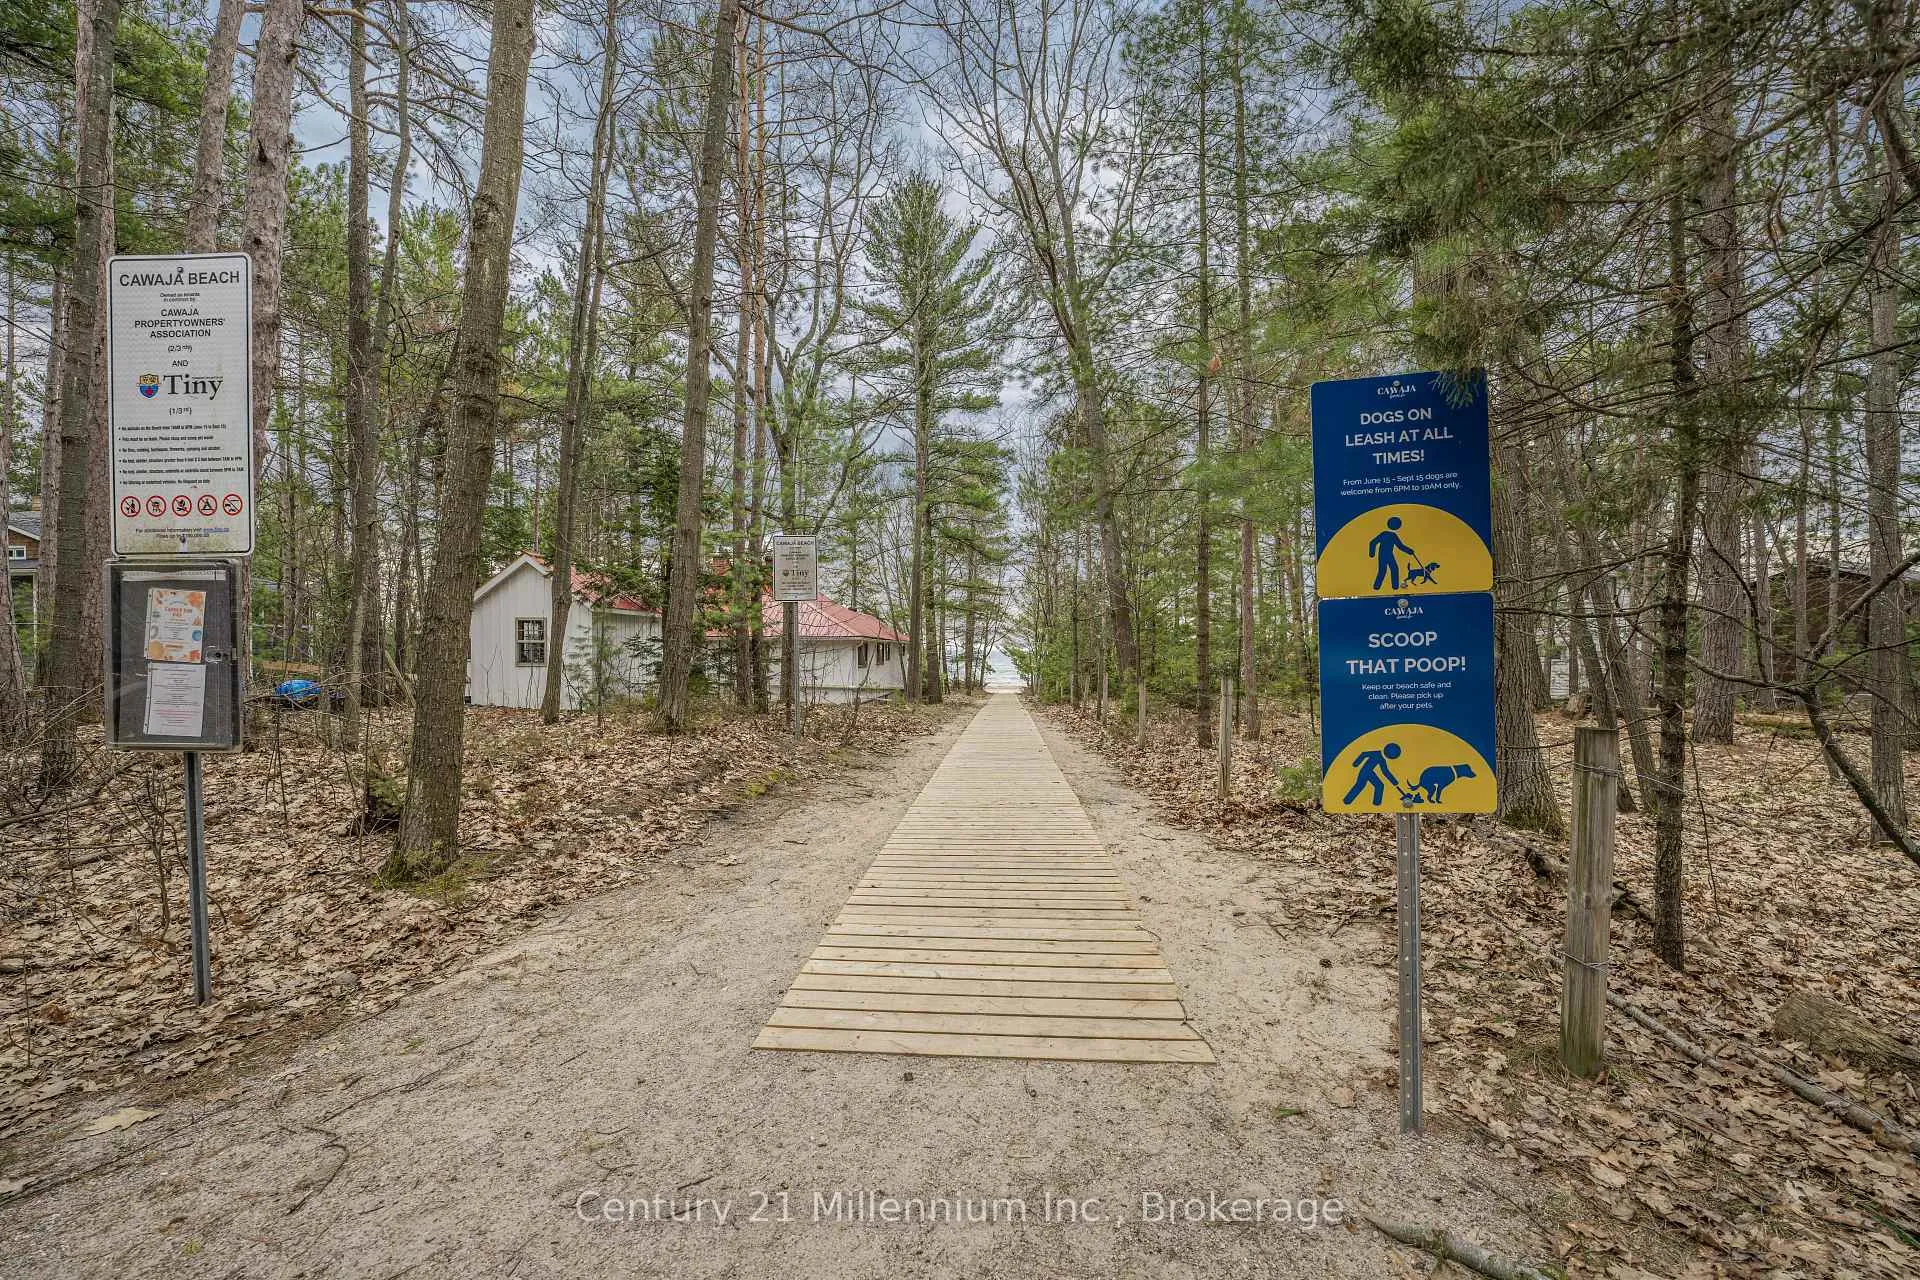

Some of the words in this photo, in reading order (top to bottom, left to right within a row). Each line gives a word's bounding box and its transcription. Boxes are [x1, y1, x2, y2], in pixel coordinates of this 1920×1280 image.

[119, 273, 184, 287] CAWAJA
[188, 271, 240, 285] BEACH
[160, 308, 199, 317] CAWAJA
[134, 318, 226, 328] PROPERTYOWNERS'
[150, 329, 211, 338] ASSOCIATION
[163, 373, 224, 400] Tiny
[1377, 384, 1417, 395] CAWAJA
[1360, 410, 1404, 425] DOGS
[1407, 407, 1432, 421] ON
[1345, 432, 1395, 447] LEASH
[1398, 429, 1420, 443] AT
[1423, 426, 1454, 441] ALL
[1372, 449, 1425, 465] TIMES!
[1363, 477, 1381, 485] June
[1397, 475, 1414, 483] Sept
[1425, 472, 1444, 481] dogs
[1340, 487, 1374, 496] welcome
[1375, 485, 1393, 494] from
[1393, 484, 1410, 492] 6PM
[1412, 483, 1420, 491] to
[1421, 482, 1442, 490] 10AM
[1384, 606, 1424, 616] CAWAJA
[1368, 631, 1438, 648] SCOOP
[1345, 658, 1399, 675] THAT
[1404, 655, 1466, 673] POOP!
[1361, 683, 1381, 691] Keep
[1396, 682, 1419, 690] beach
[1420, 681, 1436, 689] safe
[1416, 691, 1432, 700] pick
[1380, 702, 1396, 710] after
[1397, 703, 1414, 711] your
